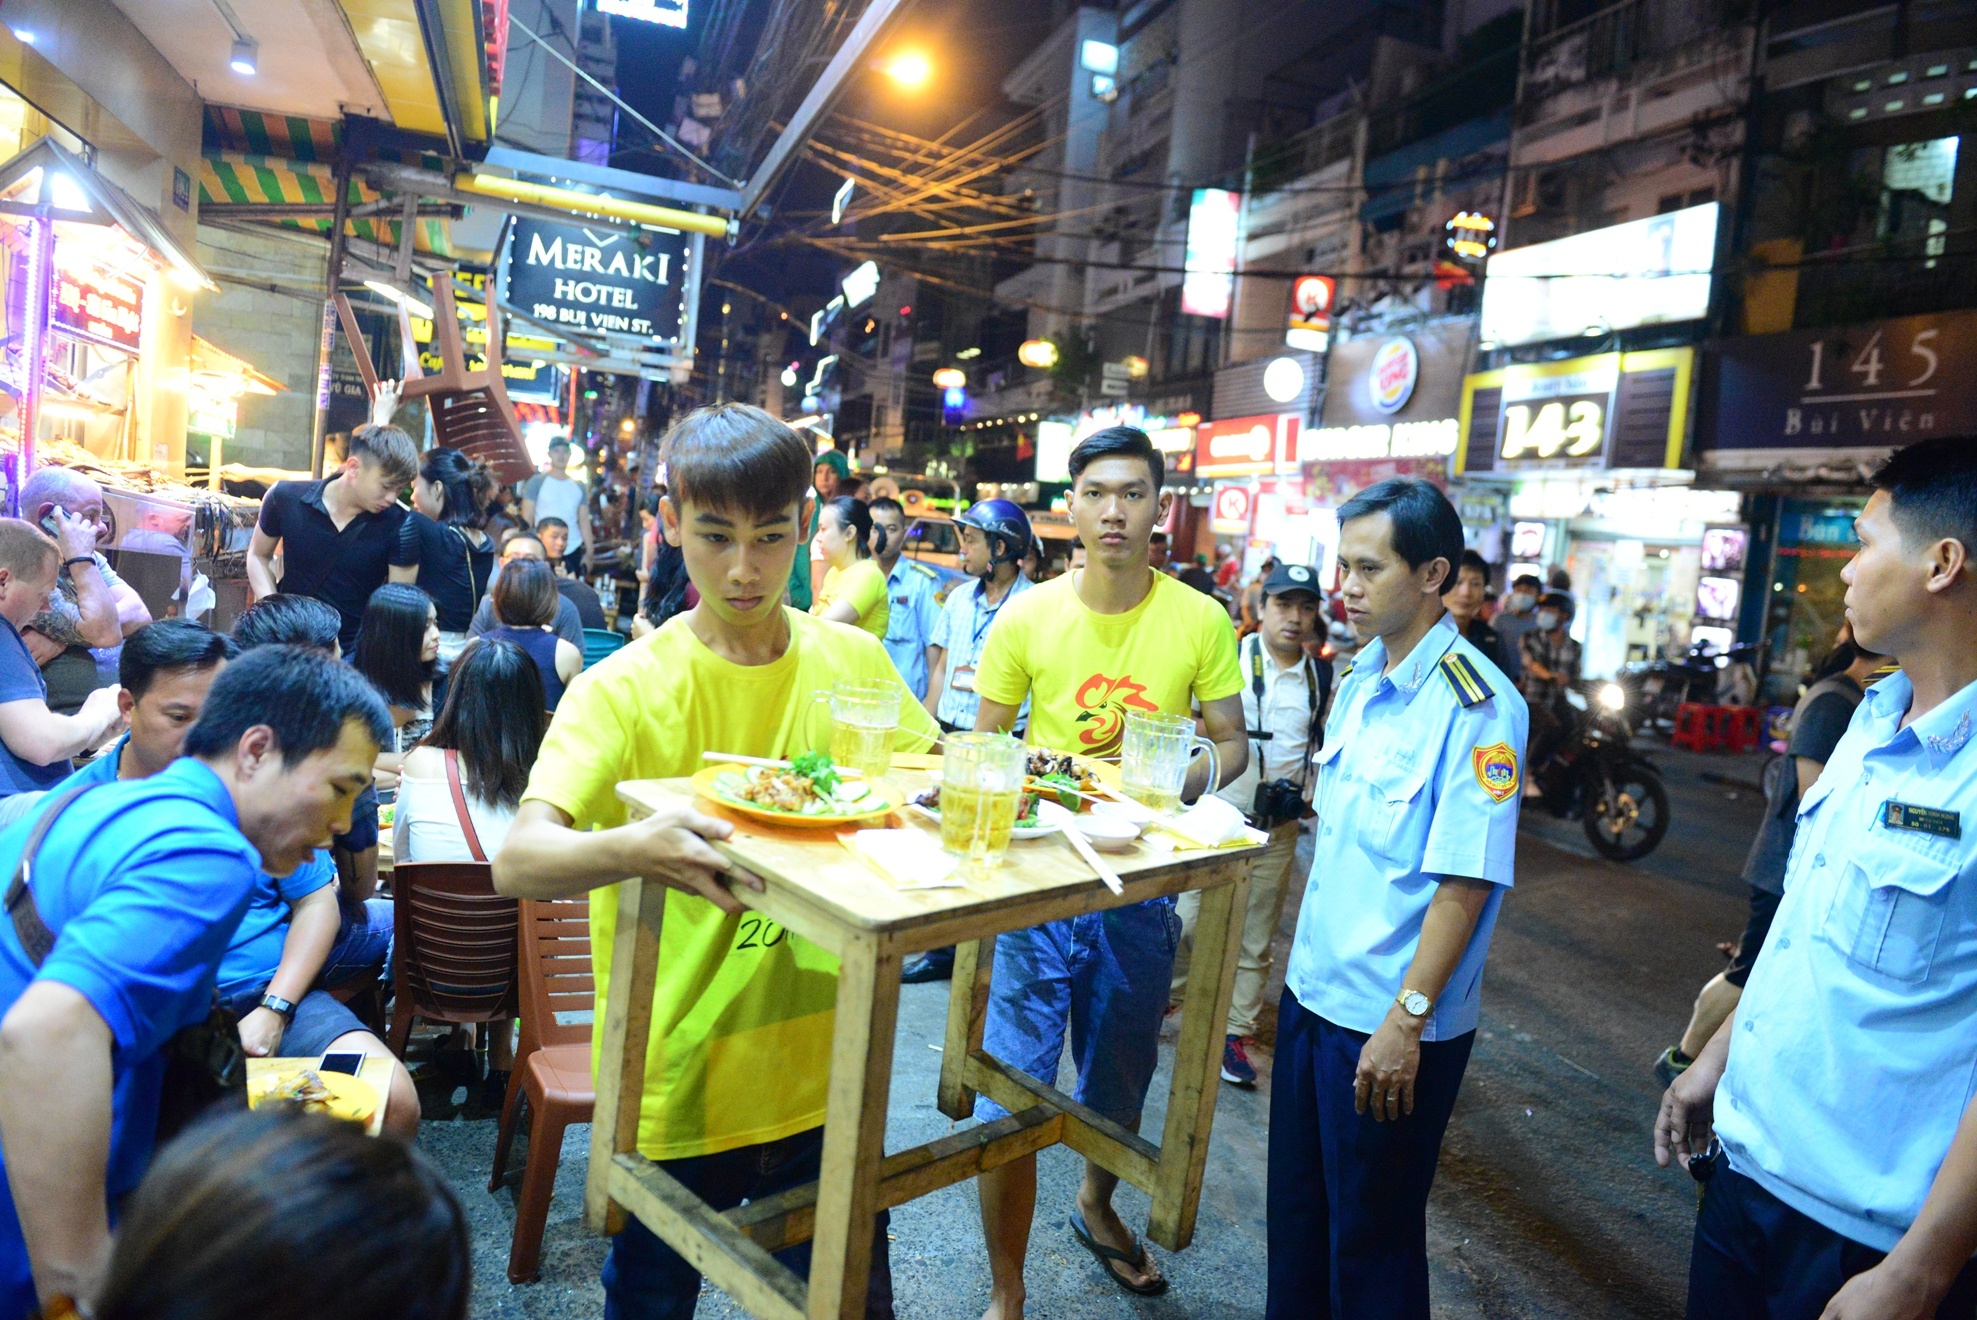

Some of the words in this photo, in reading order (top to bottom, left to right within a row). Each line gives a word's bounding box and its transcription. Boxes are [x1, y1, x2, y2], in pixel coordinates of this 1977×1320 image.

[526, 232, 671, 285] MERAKI
[533, 303, 557, 320] 198
[591, 312, 629, 331] VIEN
[631, 318, 654, 334] ST.
[553, 277, 638, 310] HOTEL
[1803, 328, 1939, 390] 145
[1501, 400, 1602, 459] 143
